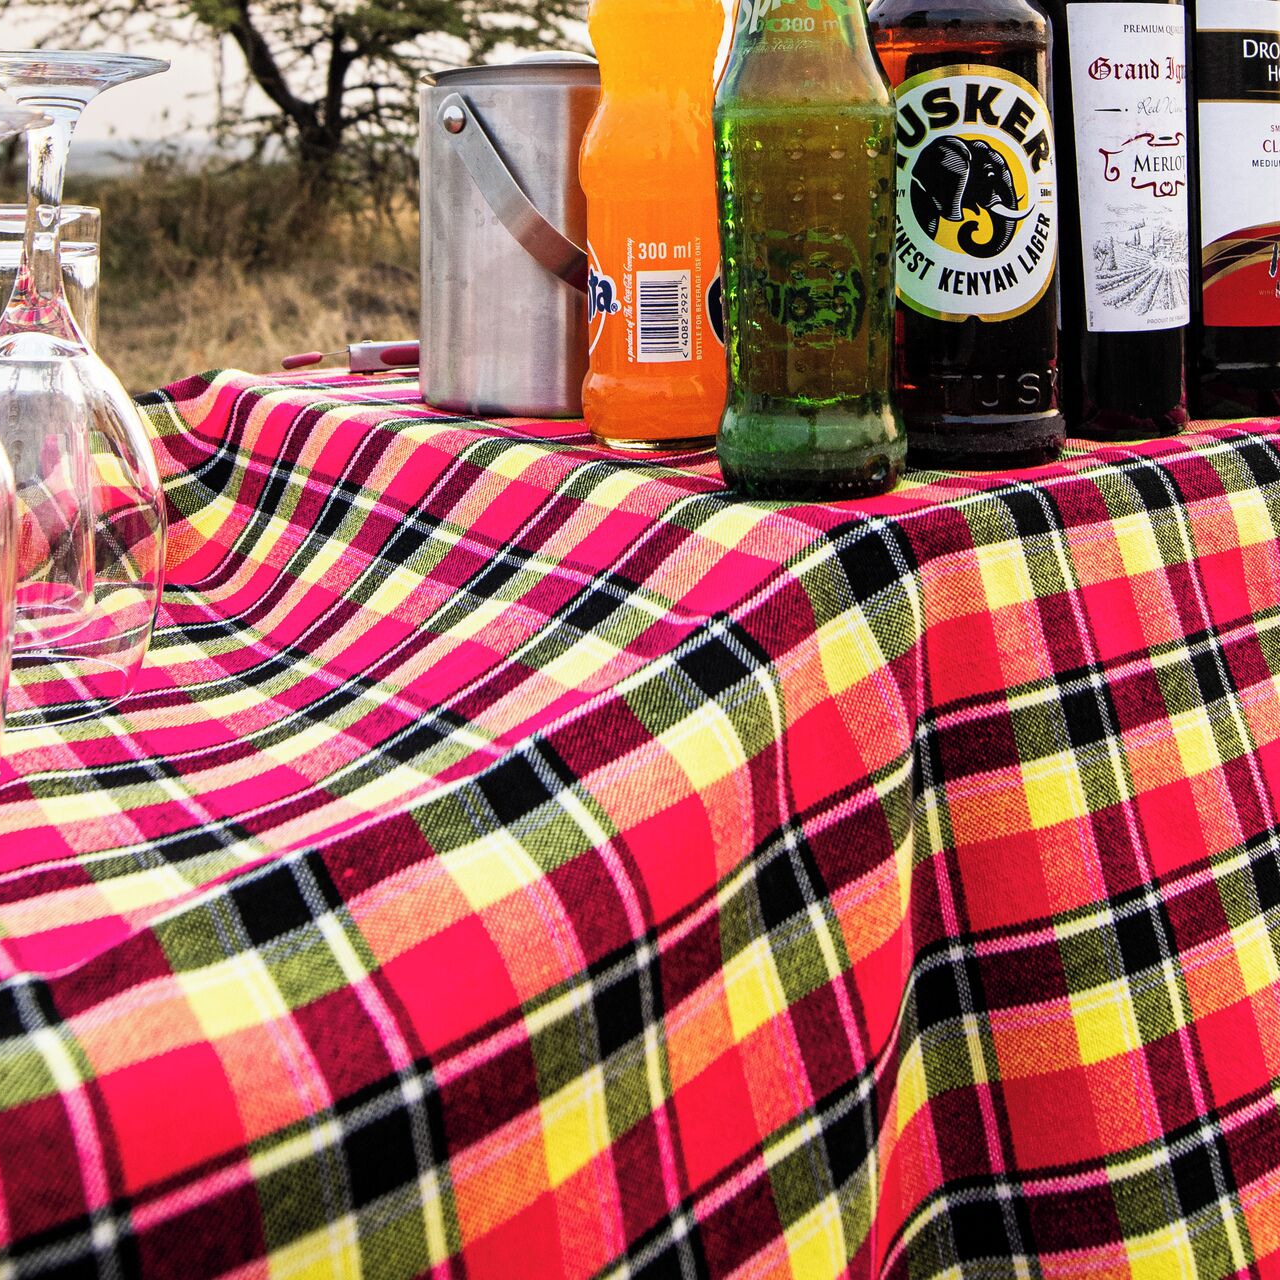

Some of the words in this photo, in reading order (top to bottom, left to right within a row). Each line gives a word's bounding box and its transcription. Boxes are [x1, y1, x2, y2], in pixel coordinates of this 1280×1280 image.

[1123, 24, 1164, 34] PREMIUM
[1088, 57, 1159, 80] Grand
[1137, 97, 1160, 116] Red
[897, 83, 1051, 174] USKER
[638, 242, 667, 259] 300
[673, 241, 691, 258] ml
[693, 236, 701, 256] ONLY
[938, 262, 1019, 296] KENYAN
[1018, 212, 1051, 274] LAGER
[694, 258, 702, 272] USE
[681, 286, 689, 314] 2921
[694, 275, 702, 313] BEVERAGE
[625, 318, 635, 329] of
[681, 318, 689, 346] 4082
[695, 314, 703, 329] FOR
[695, 331, 703, 361] BOTTLE
